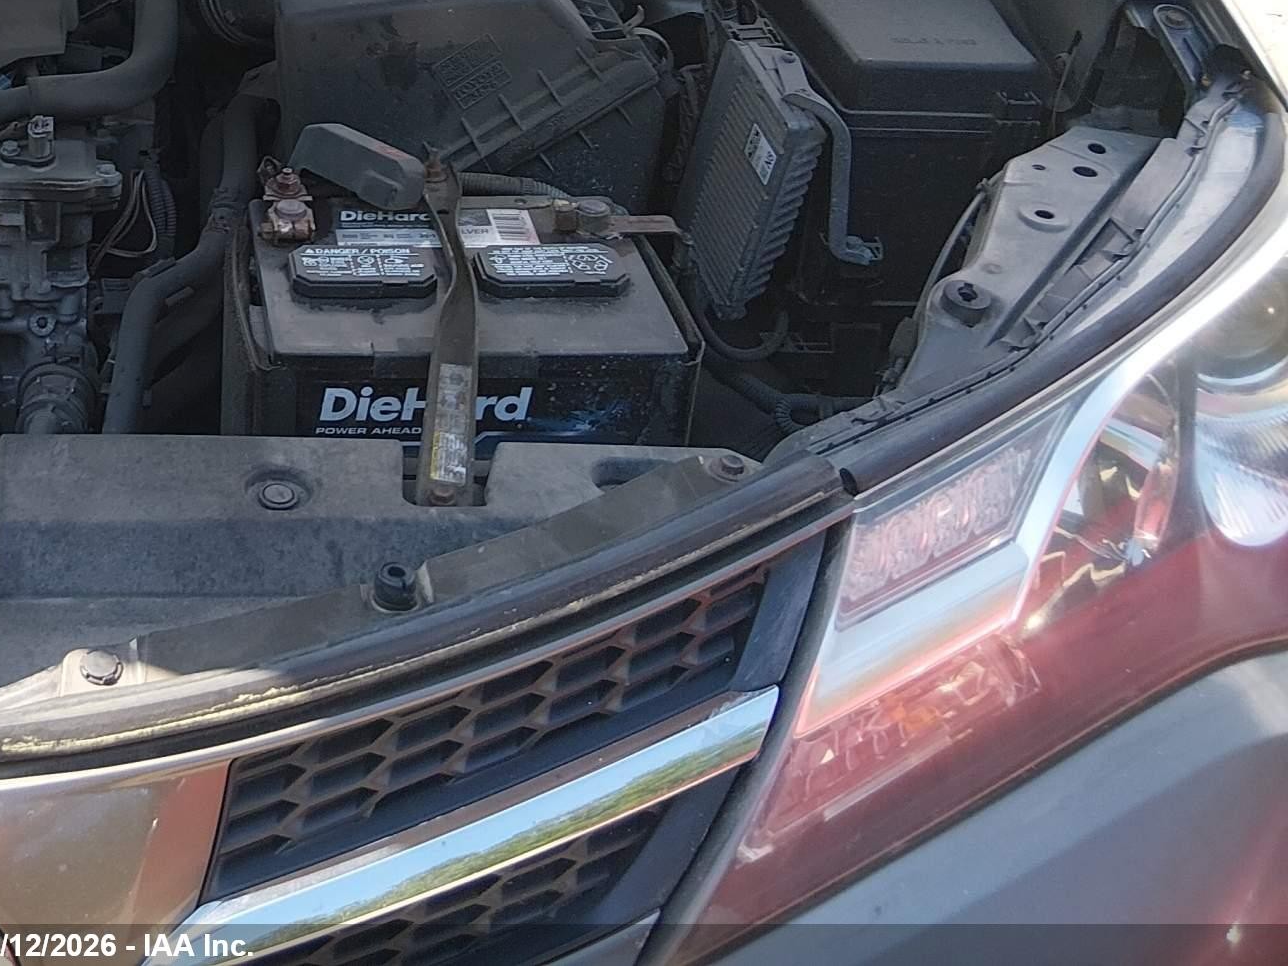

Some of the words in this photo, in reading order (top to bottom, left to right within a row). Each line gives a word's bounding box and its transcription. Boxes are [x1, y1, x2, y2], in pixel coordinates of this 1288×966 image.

[319, 386, 534, 422] DieHrd
[315, 427, 367, 435] POWER
[371, 427, 422, 435] AHEAD
